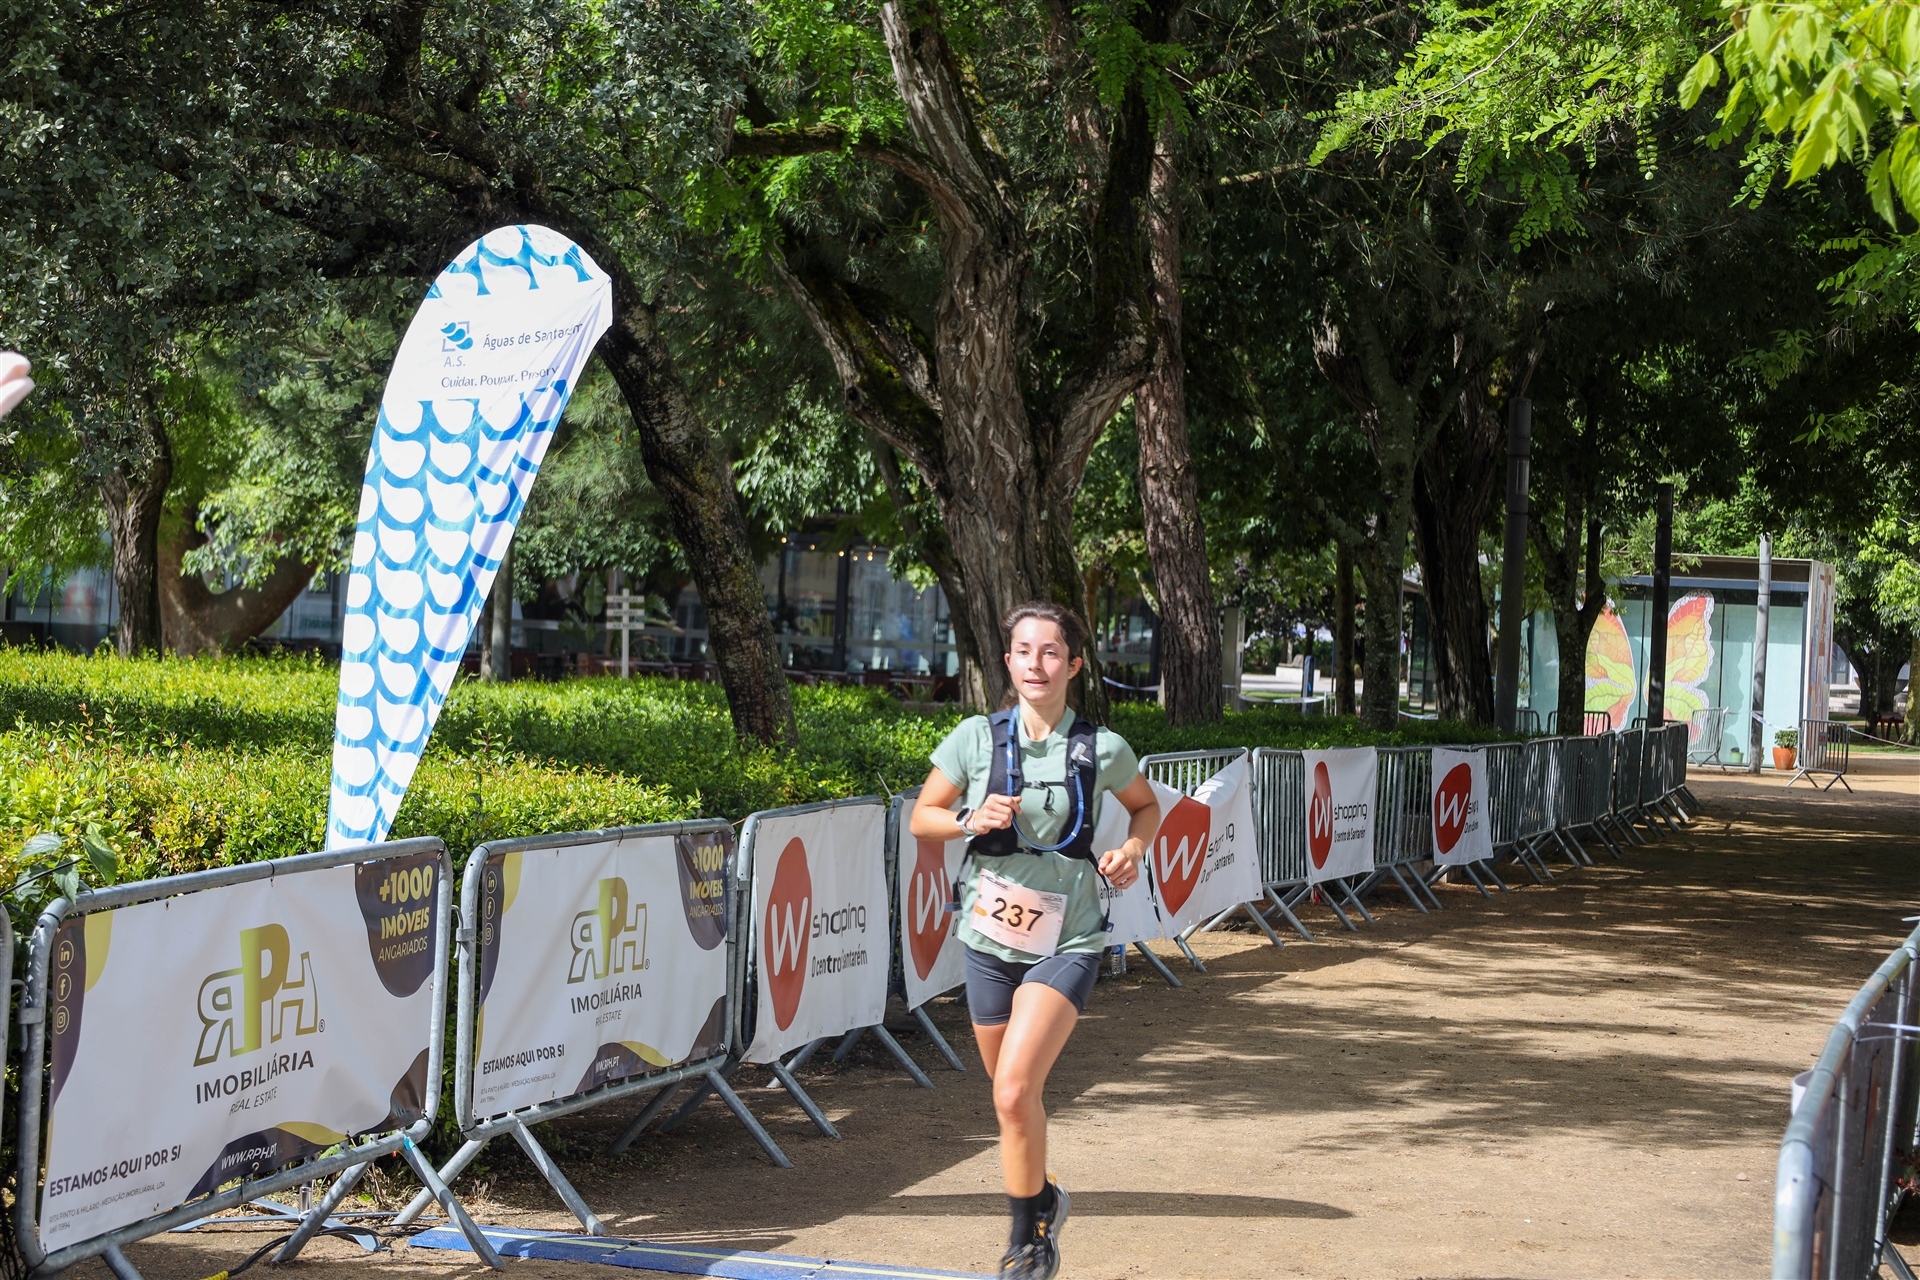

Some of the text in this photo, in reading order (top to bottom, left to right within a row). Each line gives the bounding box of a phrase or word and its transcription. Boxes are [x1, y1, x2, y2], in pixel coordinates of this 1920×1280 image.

[483, 333, 515, 351] Águas
[517, 332, 531, 344] de
[441, 376, 478, 388] Cuidar.
[480, 374, 518, 386] Poupar.
[1314, 795, 1332, 839] W
[1334, 801, 1368, 822] shopping
[693, 844, 724, 872] +1000
[1160, 832, 1206, 884] W
[379, 864, 434, 905] +1000
[690, 876, 724, 900] IMÓVEIS
[380, 906, 430, 940] IMÓVEIS
[991, 897, 1044, 932] 237
[378, 936, 428, 962] ANGARIADOS
[771, 896, 809, 976] W
[483, 1044, 565, 1075] ESTAMOS AQUI POR SI
[196, 1050, 314, 1104] IMOBILIÁRIA
[229, 1086, 278, 1116] REAL ESTATE
[50, 1144, 182, 1198] ESTAMOS AQUI POR SI
[222, 1143, 278, 1170] WWW.RPH.PT
[60, 1209, 76, 1221] PINTO
